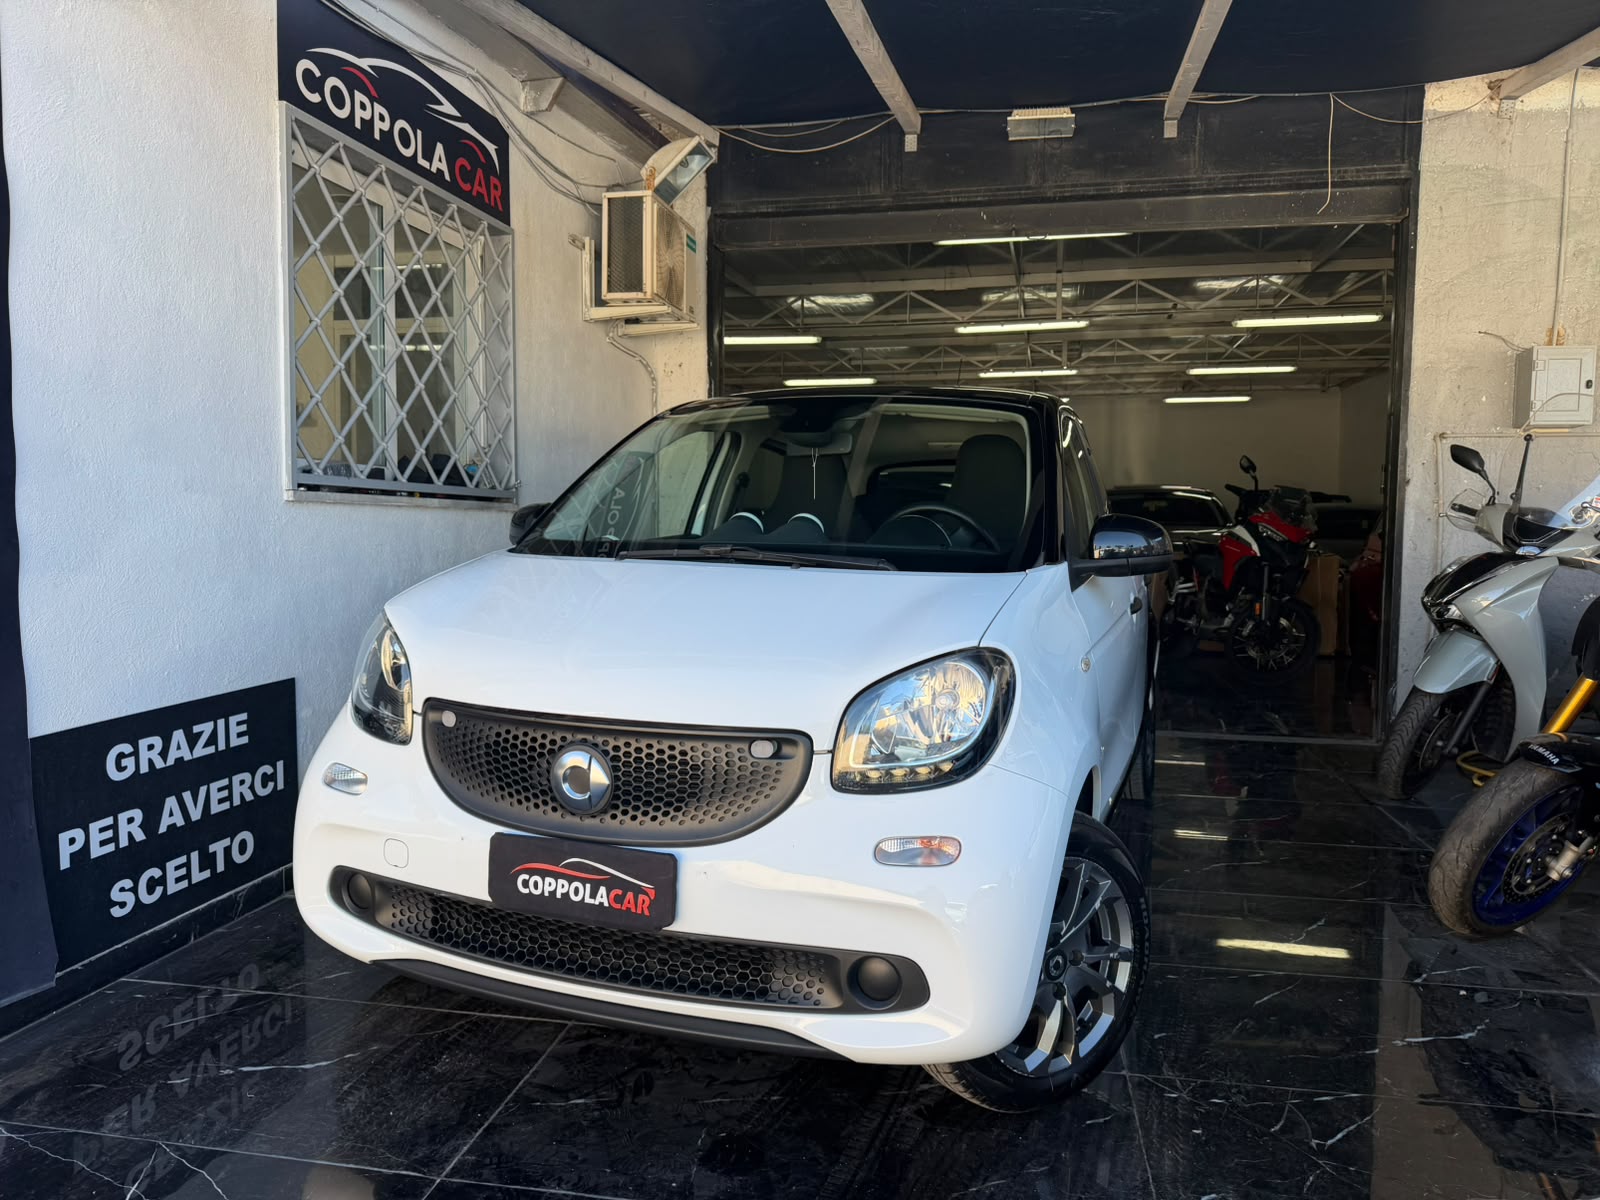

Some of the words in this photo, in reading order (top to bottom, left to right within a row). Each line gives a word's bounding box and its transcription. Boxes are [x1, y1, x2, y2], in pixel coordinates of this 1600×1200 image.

[106, 712, 249, 782] GRAZIE
[1528, 744, 1559, 765] YAMAHA
[58, 808, 146, 870] PER
[158, 760, 285, 834] AVERCI
[109, 830, 255, 918] SCELTO
